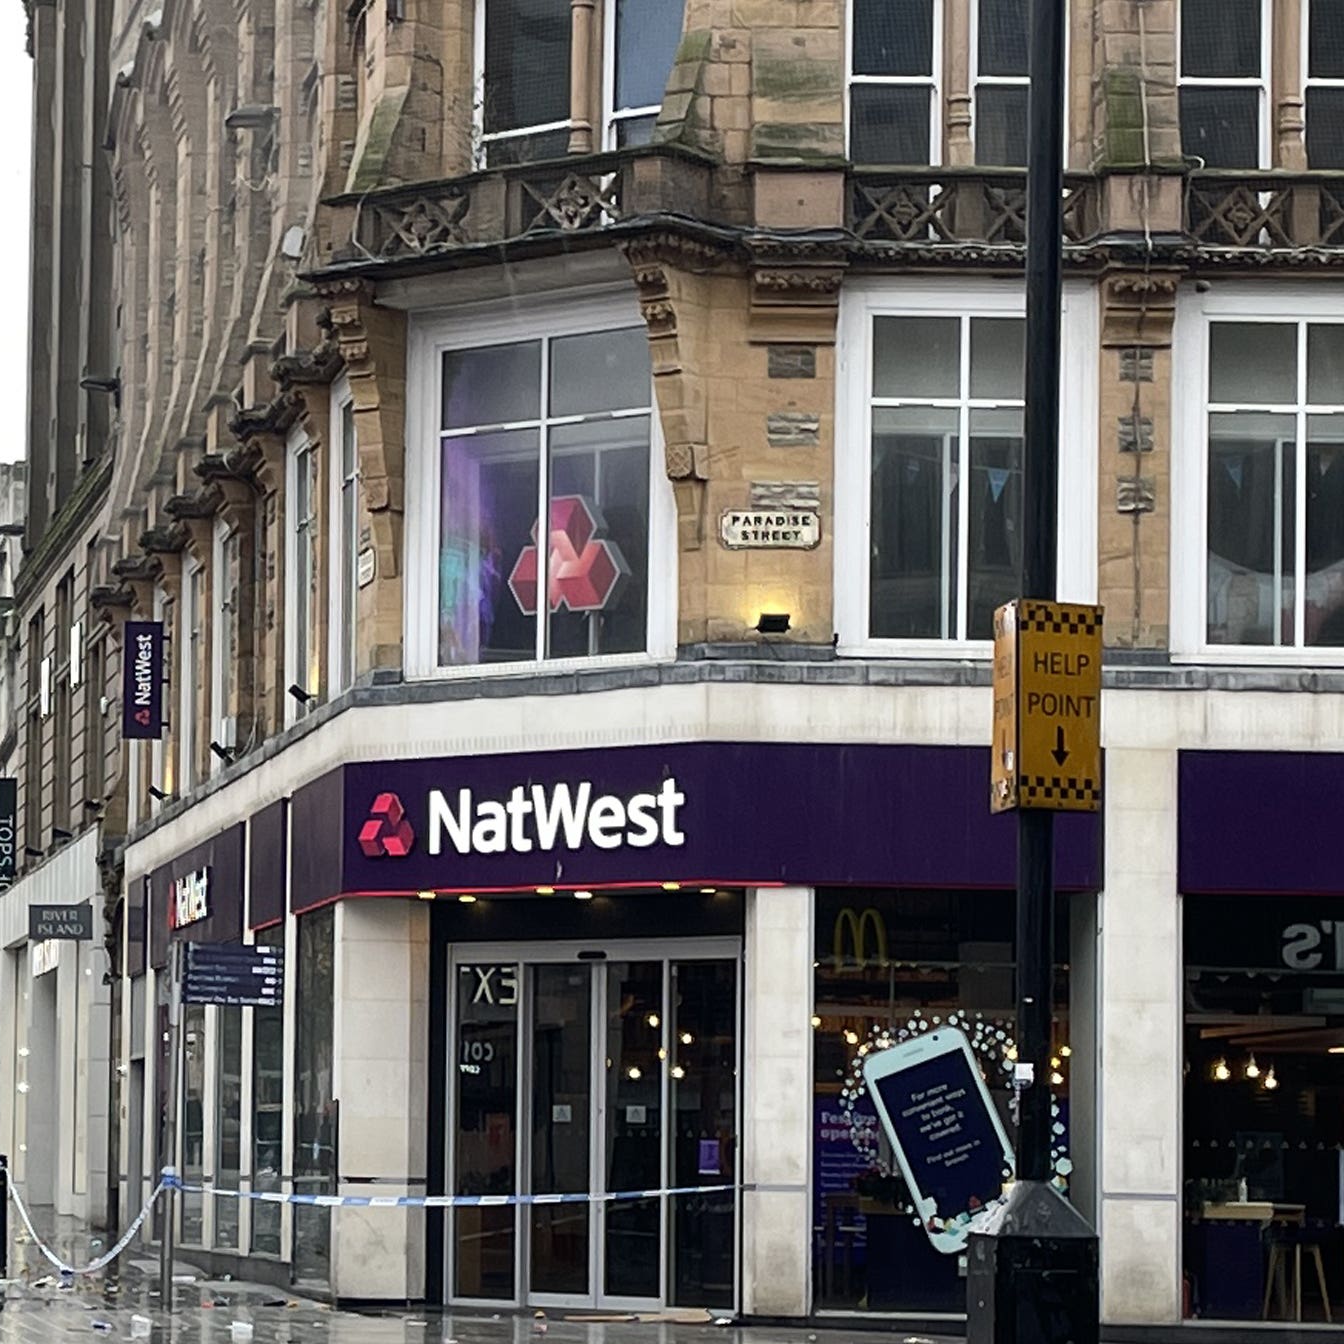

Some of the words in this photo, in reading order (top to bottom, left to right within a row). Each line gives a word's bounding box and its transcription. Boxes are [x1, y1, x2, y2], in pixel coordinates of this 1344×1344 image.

[731, 515, 811, 527] PARADISE
[741, 530, 801, 541] STREET
[134, 634, 153, 706] NatWest
[1033, 651, 1090, 676] HELP
[1027, 692, 1097, 718] POINT
[428, 778, 685, 855] NatWest
[42, 910, 78, 922] RIVER
[38, 923, 84, 936] ISLAND
